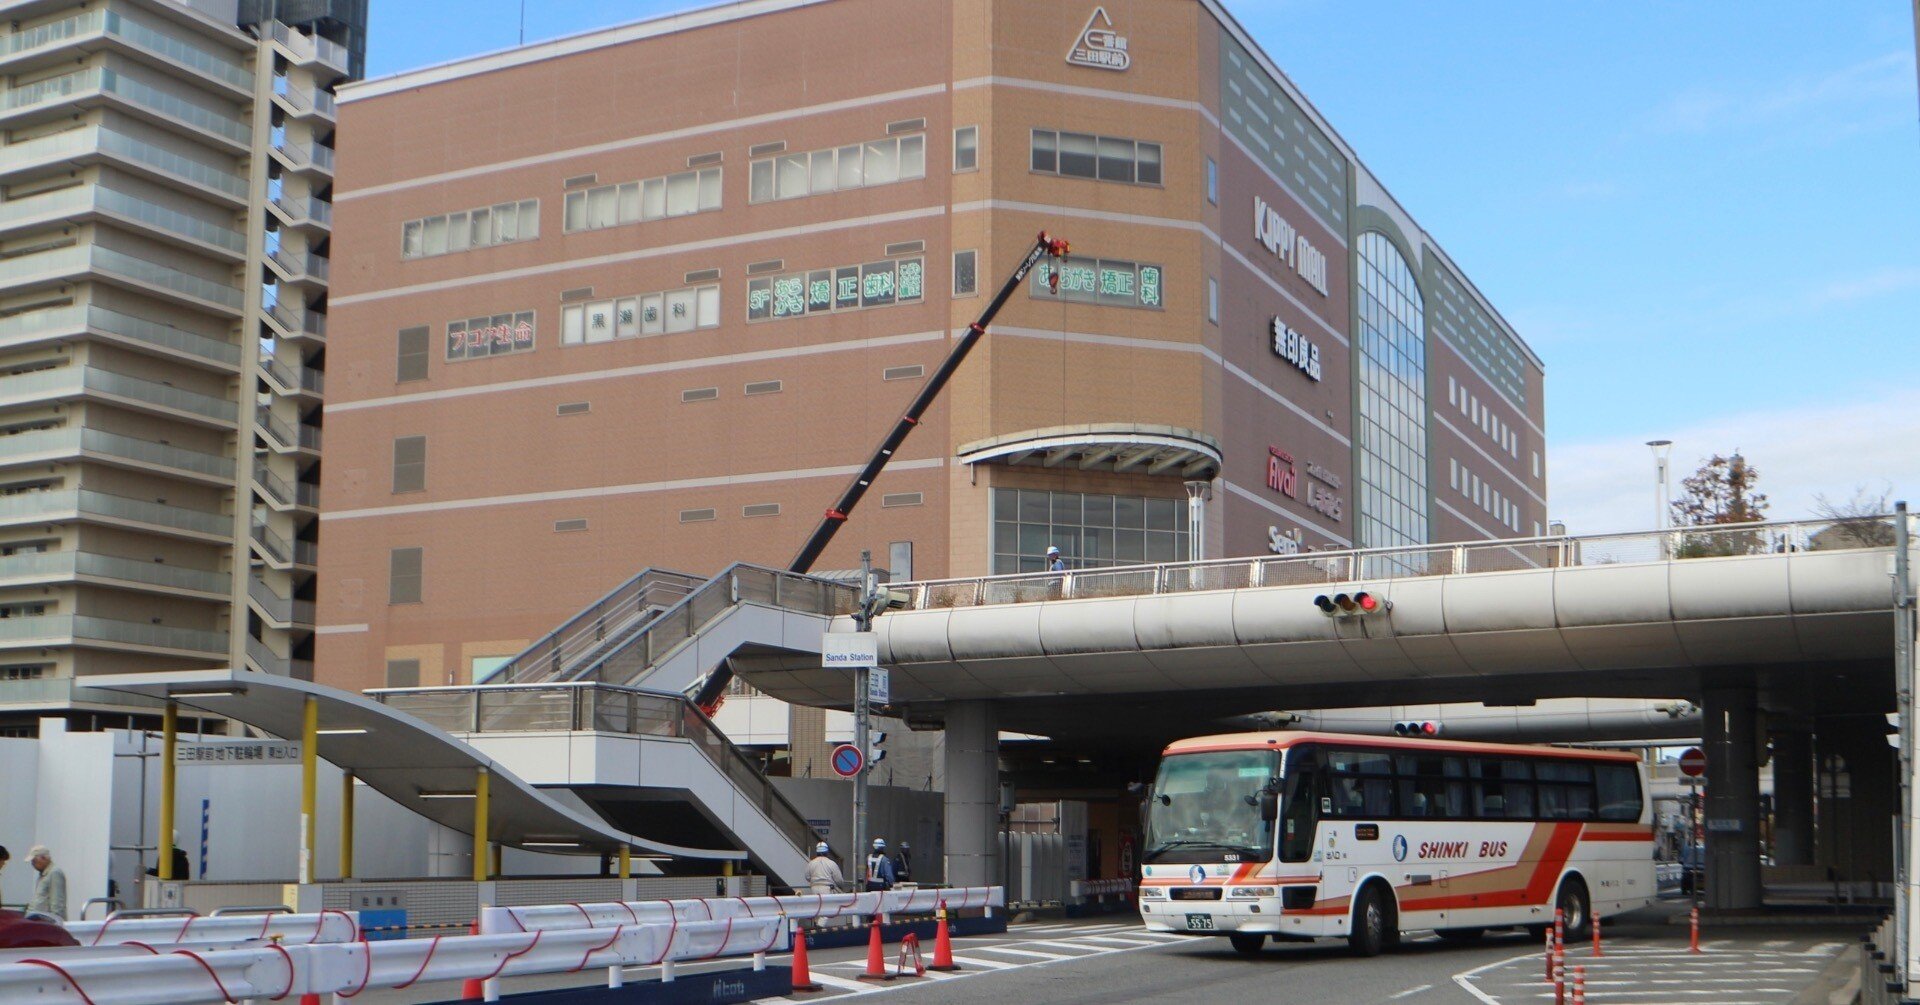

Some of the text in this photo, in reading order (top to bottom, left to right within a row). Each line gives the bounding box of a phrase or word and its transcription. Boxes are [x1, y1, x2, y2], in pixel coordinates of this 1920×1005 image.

[1254, 195, 1329, 297] KIPPY MALL
[750, 289, 770, 310] 5F
[1273, 315, 1321, 382] 無印良品
[1267, 456, 1297, 499] Avail
[825, 653, 874, 662] Sanda Station
[1418, 840, 1508, 859] SHINKI BUS
